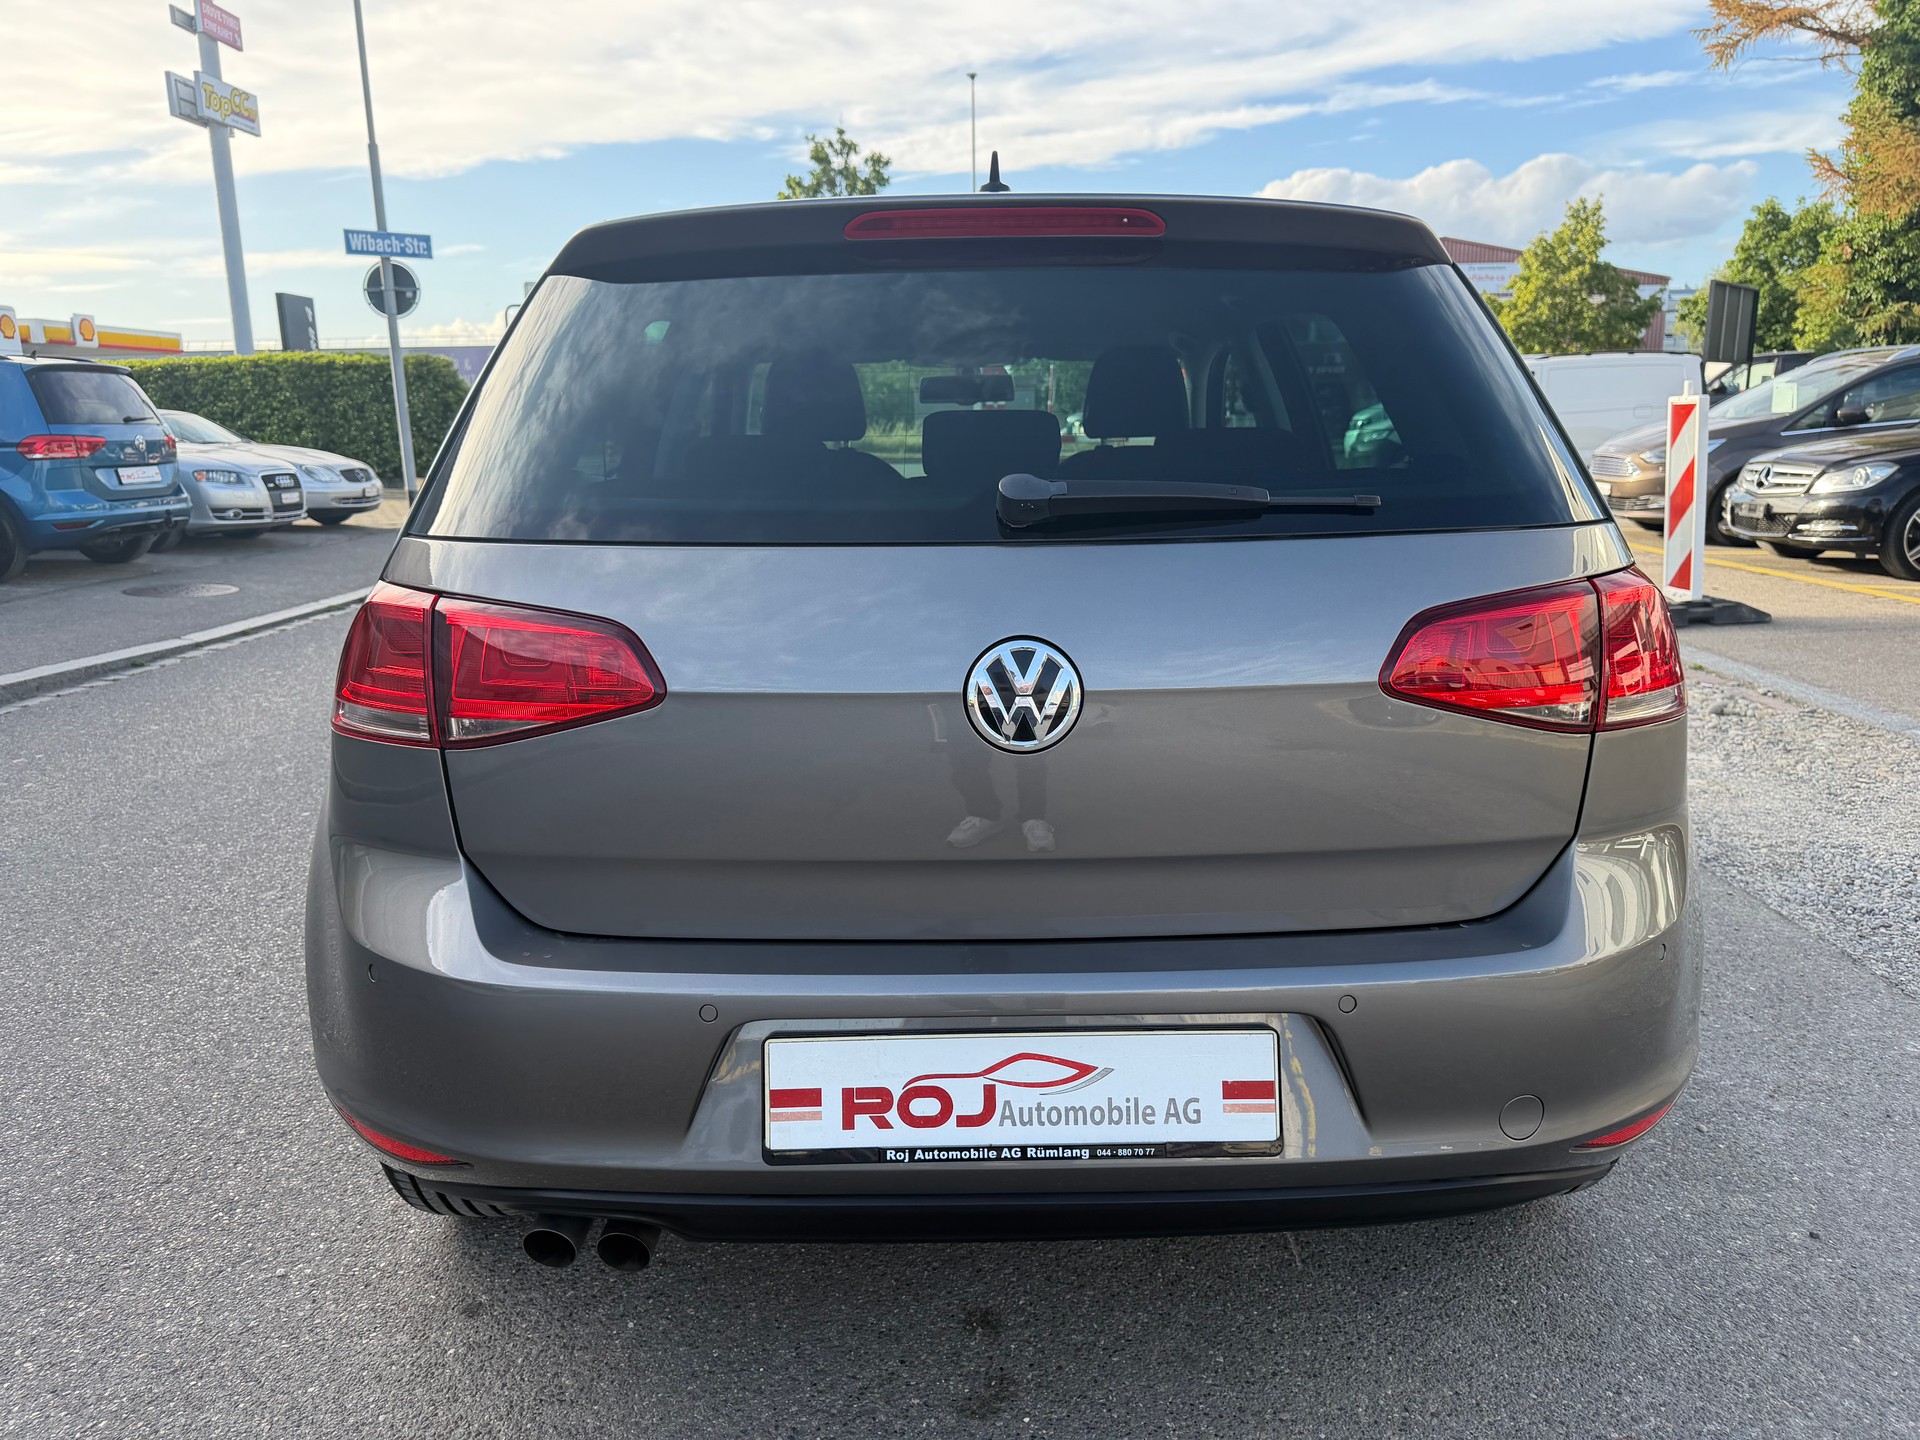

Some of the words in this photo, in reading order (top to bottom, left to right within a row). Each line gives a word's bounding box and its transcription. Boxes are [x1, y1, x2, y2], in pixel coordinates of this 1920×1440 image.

[202, 81, 249, 121] TopCC
[347, 232, 428, 255] Wibach-Str.
[841, 1083, 997, 1131] ROJ
[998, 1096, 1156, 1127] Automobile
[1163, 1097, 1202, 1125] AG
[886, 1149, 910, 1162] Roj
[914, 1148, 997, 1160] Automobile
[1001, 1148, 1022, 1159] AG
[1027, 1146, 1090, 1159] Rümlang
[1096, 1148, 1112, 1157] 044
[1117, 1148, 1132, 1157] 880
[1133, 1148, 1144, 1156] 70
[1145, 1147, 1155, 1156] 77
